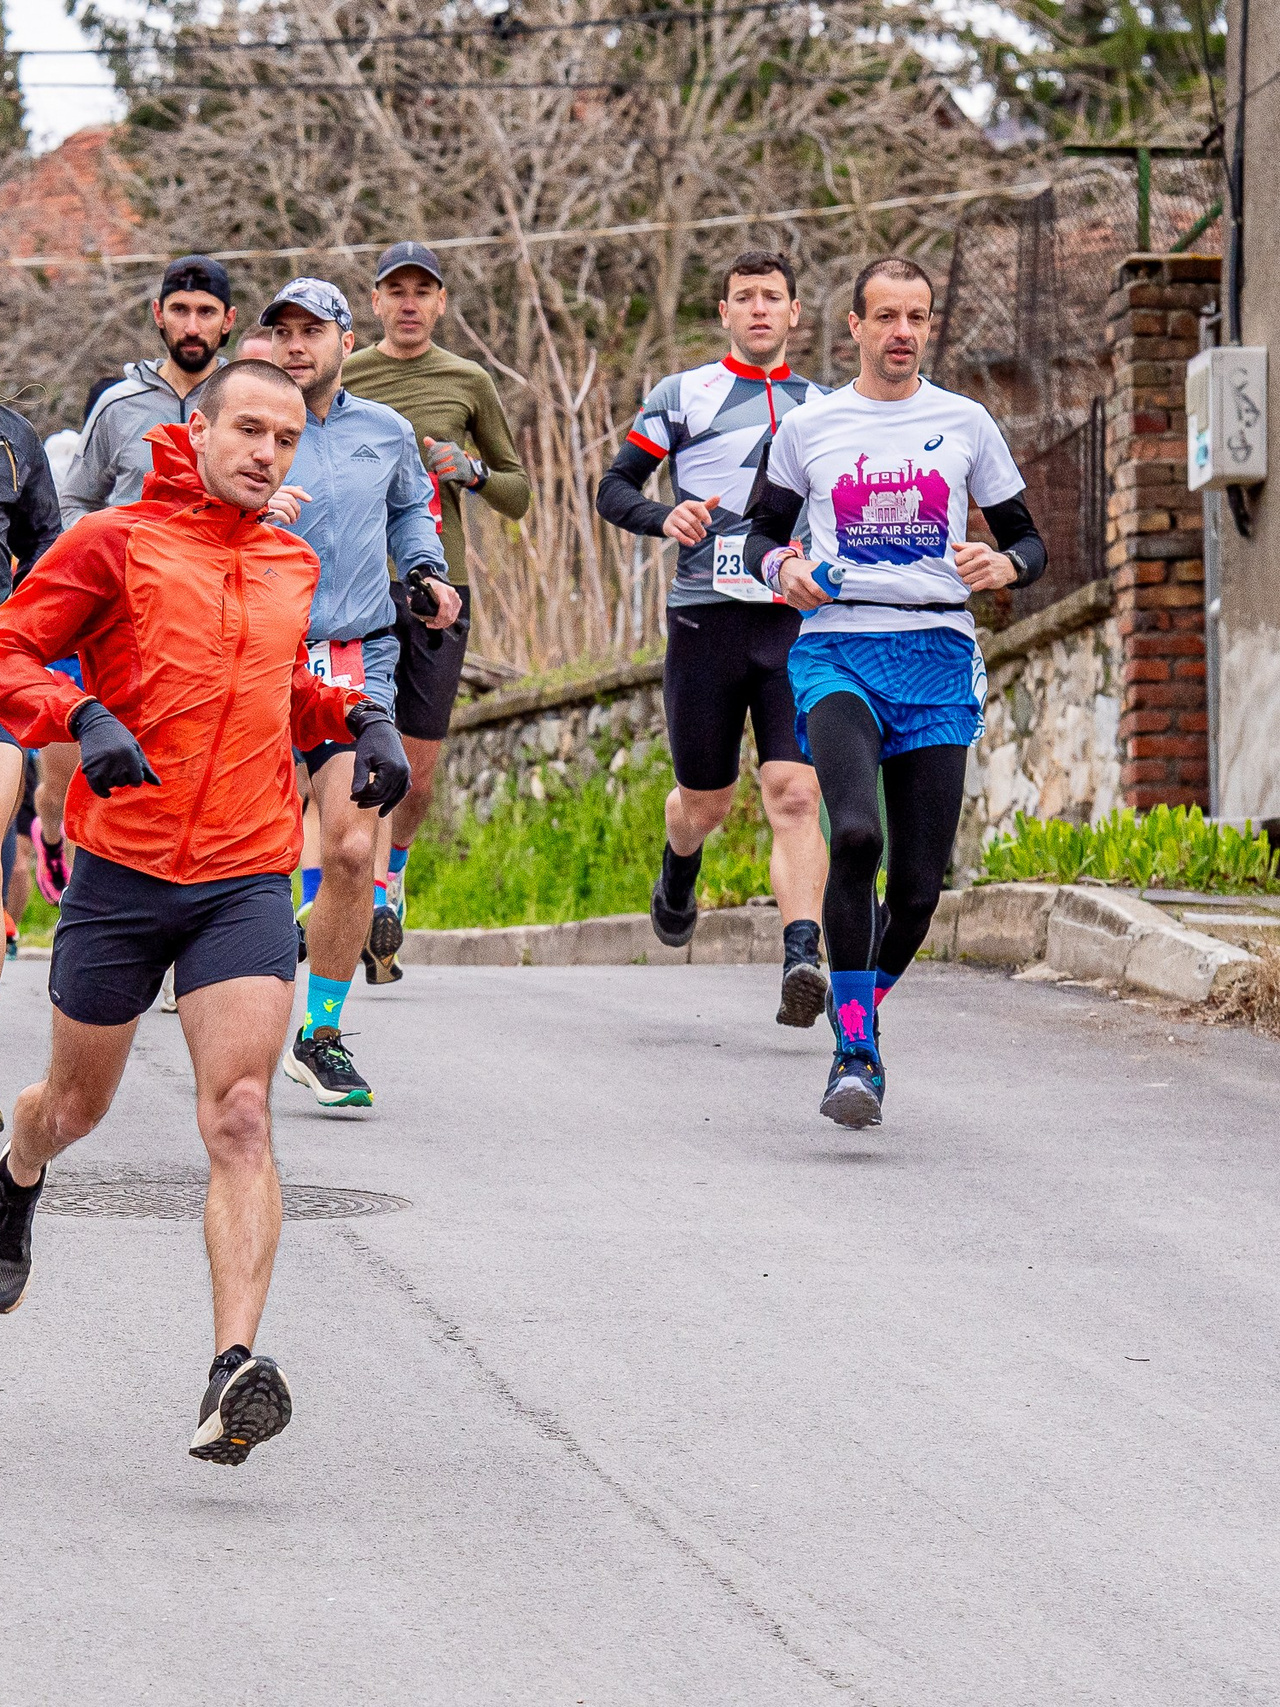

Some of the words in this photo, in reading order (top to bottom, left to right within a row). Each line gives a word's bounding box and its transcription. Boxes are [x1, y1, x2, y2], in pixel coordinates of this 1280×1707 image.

[845, 525, 878, 535] WIZZ
[881, 525, 902, 535] AIR
[904, 524, 940, 535] SOFIA
[847, 537, 911, 547] MARATHON
[915, 537, 940, 546] 2023
